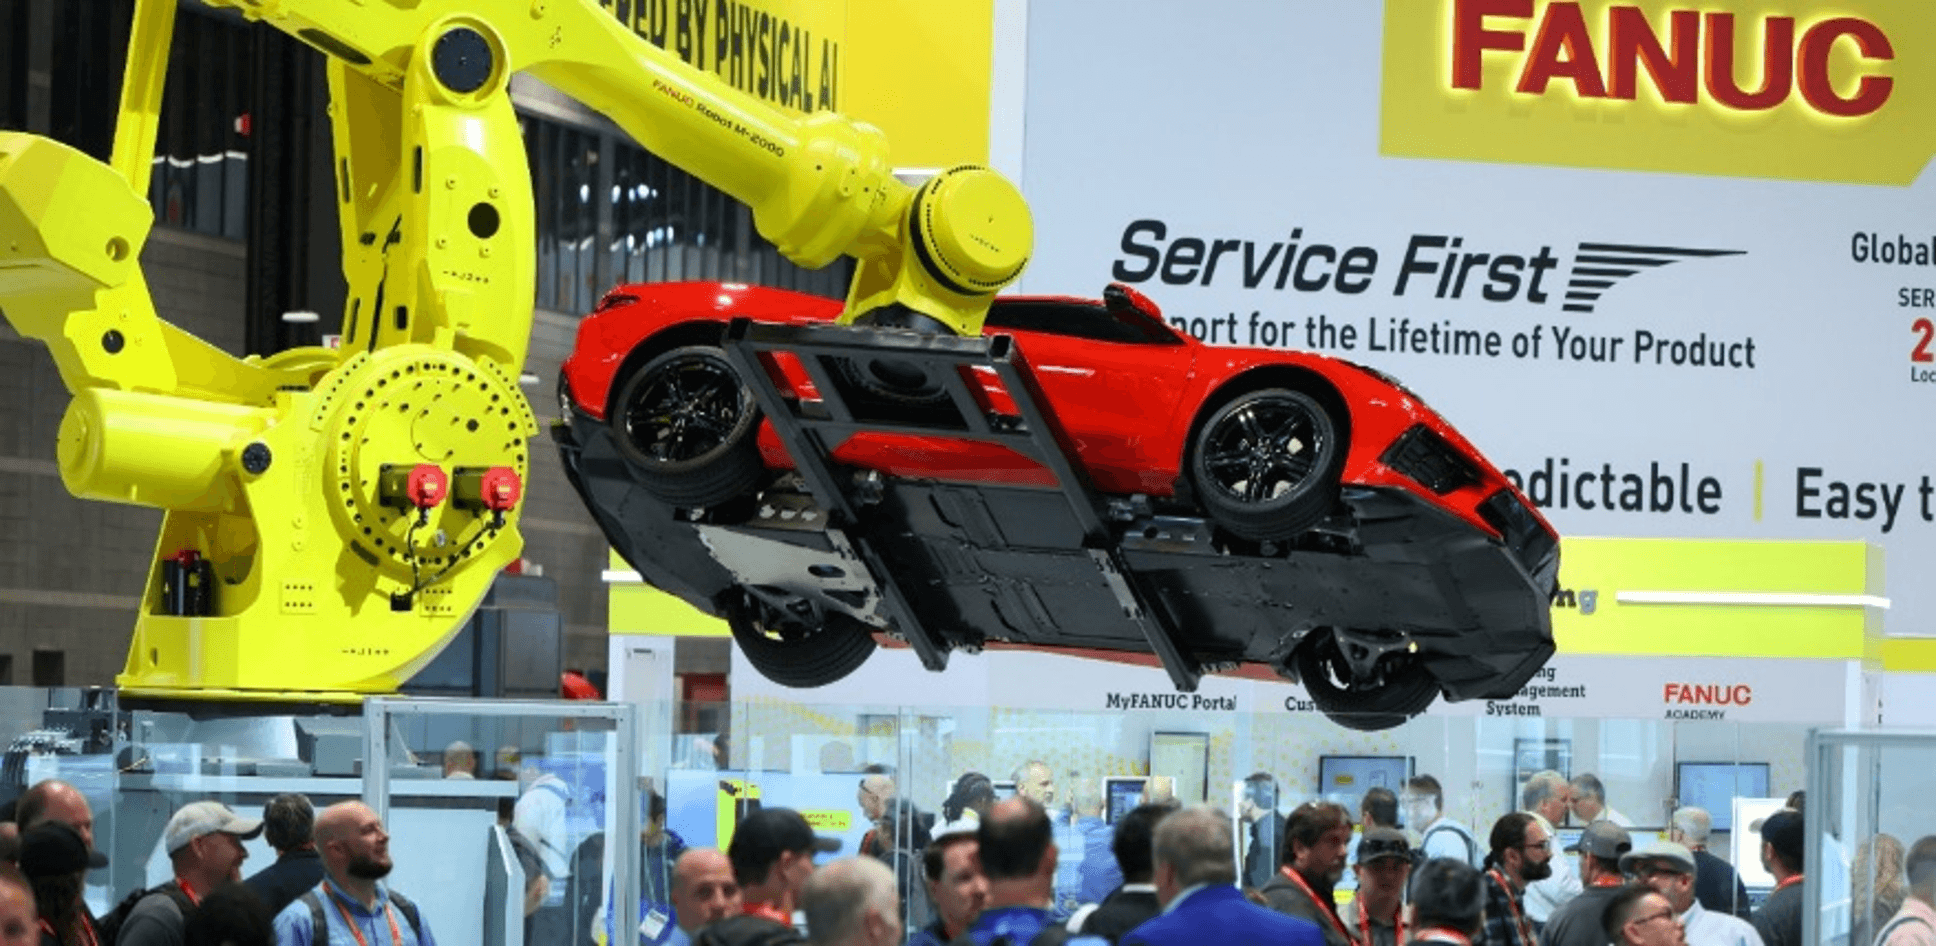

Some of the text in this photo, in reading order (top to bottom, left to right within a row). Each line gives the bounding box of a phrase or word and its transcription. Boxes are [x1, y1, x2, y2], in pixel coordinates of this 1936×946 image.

[676, 0, 710, 71] BY
[714, 0, 812, 113] PHYSICAL
[819, 38, 837, 113] AI
[1452, 0, 1895, 117] FANUC
[653, 80, 784, 157] FANUC Robot M-2000
[1112, 219, 1558, 303] Service First
[1851, 231, 1936, 265] Global
[1898, 287, 1935, 307] SER
[1248, 311, 1296, 347] for
[1306, 314, 1357, 350] the
[1369, 317, 1501, 356] Lifetime
[1512, 325, 1542, 359] of
[1552, 326, 1624, 363] Your
[1634, 330, 1756, 369] Product
[1911, 317, 1935, 363] 2
[1796, 467, 1906, 534] Easy
[1106, 692, 1237, 711] MyFANUC Portal
[1486, 700, 1541, 717] System
[1664, 683, 1751, 706] FANUC
[1664, 709, 1726, 720] ACADEMY
